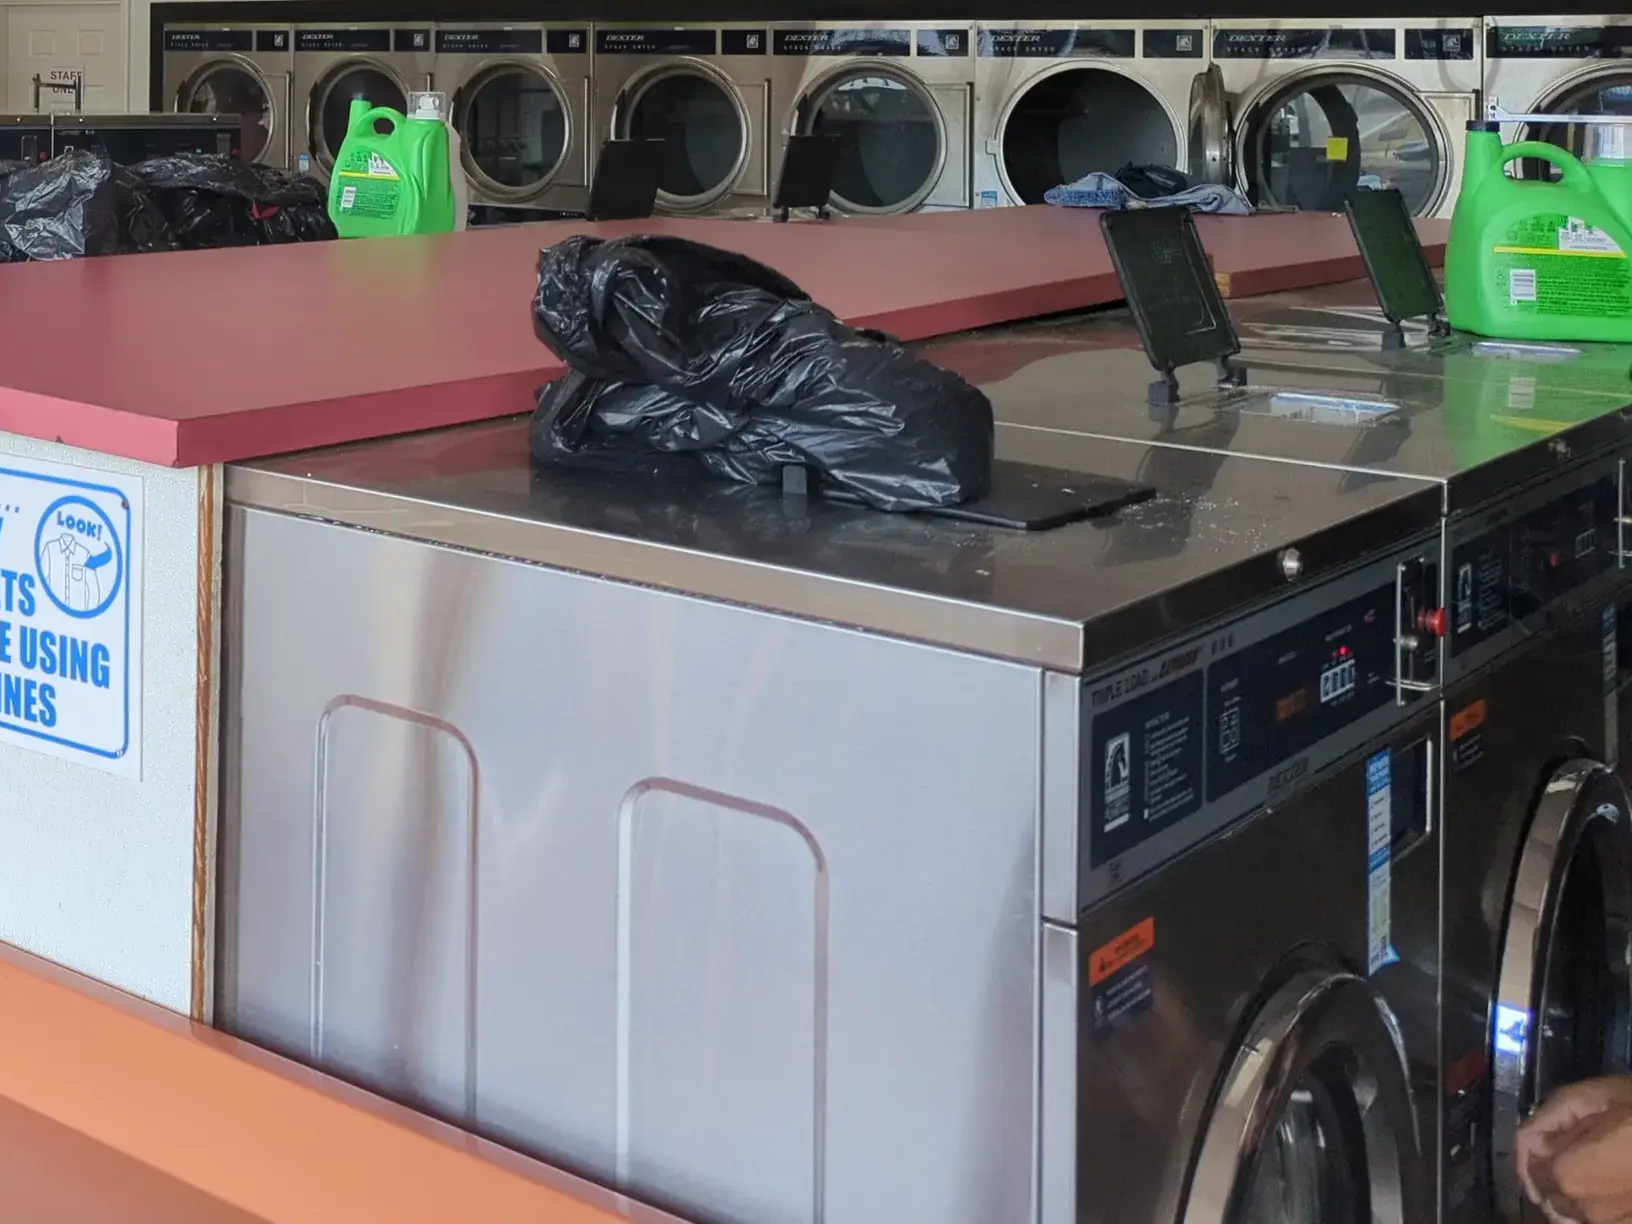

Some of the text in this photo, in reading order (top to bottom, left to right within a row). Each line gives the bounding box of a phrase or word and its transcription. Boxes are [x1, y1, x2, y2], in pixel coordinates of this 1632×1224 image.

[784, 34, 830, 42] DEXTER
[990, 34, 1041, 43] DEXTER
[1228, 34, 1287, 43] DEXTER
[1502, 32, 1571, 42] DEXTER
[57, 510, 103, 540] LOOK!
[19, 625, 110, 689] USING
